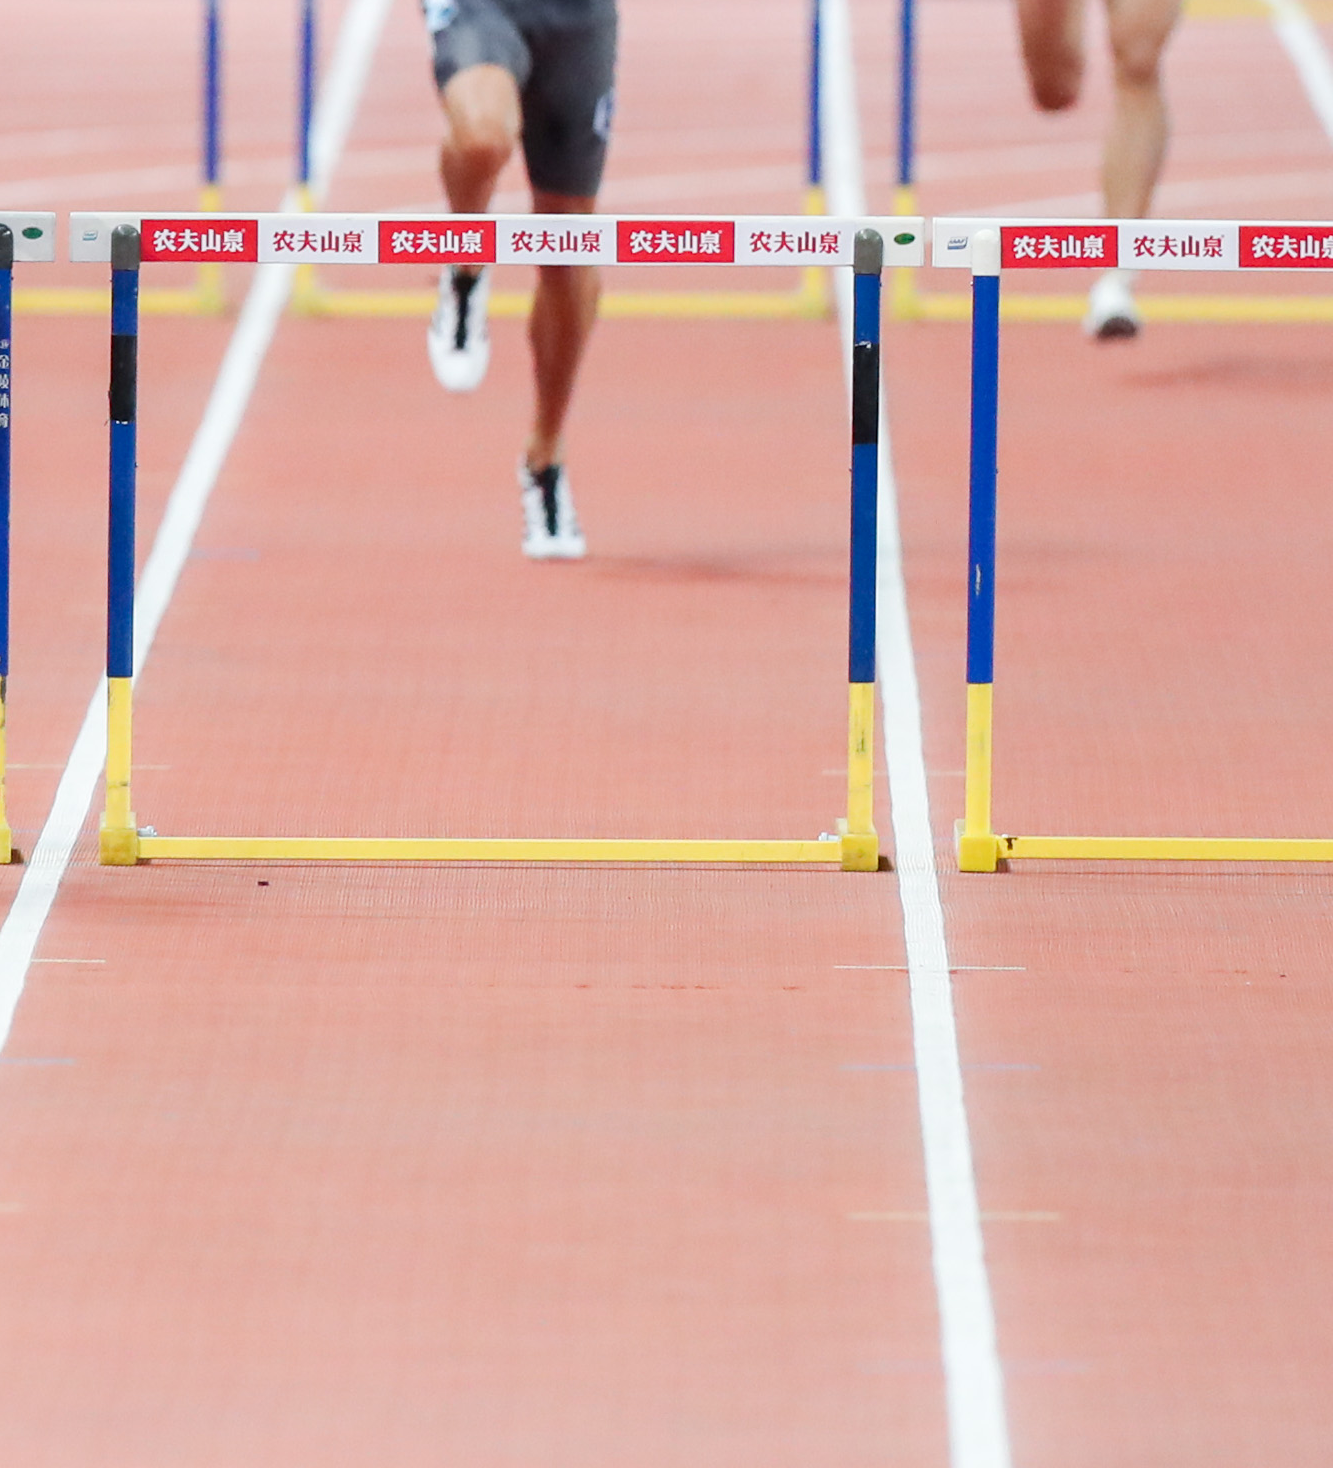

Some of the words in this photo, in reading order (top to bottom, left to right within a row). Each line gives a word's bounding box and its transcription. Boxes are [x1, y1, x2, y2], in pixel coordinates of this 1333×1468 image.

[154, 228, 243, 253] 农夫山泉
[273, 231, 362, 253] 农夫山泉
[392, 229, 482, 254] 农夫山泉
[511, 231, 601, 253] 农夫山泉
[630, 230, 721, 254] 农夫山泉
[750, 231, 839, 254] 农夫山泉
[1013, 234, 1104, 259] 农夫山泉
[1133, 235, 1223, 257] 农夫山泉
